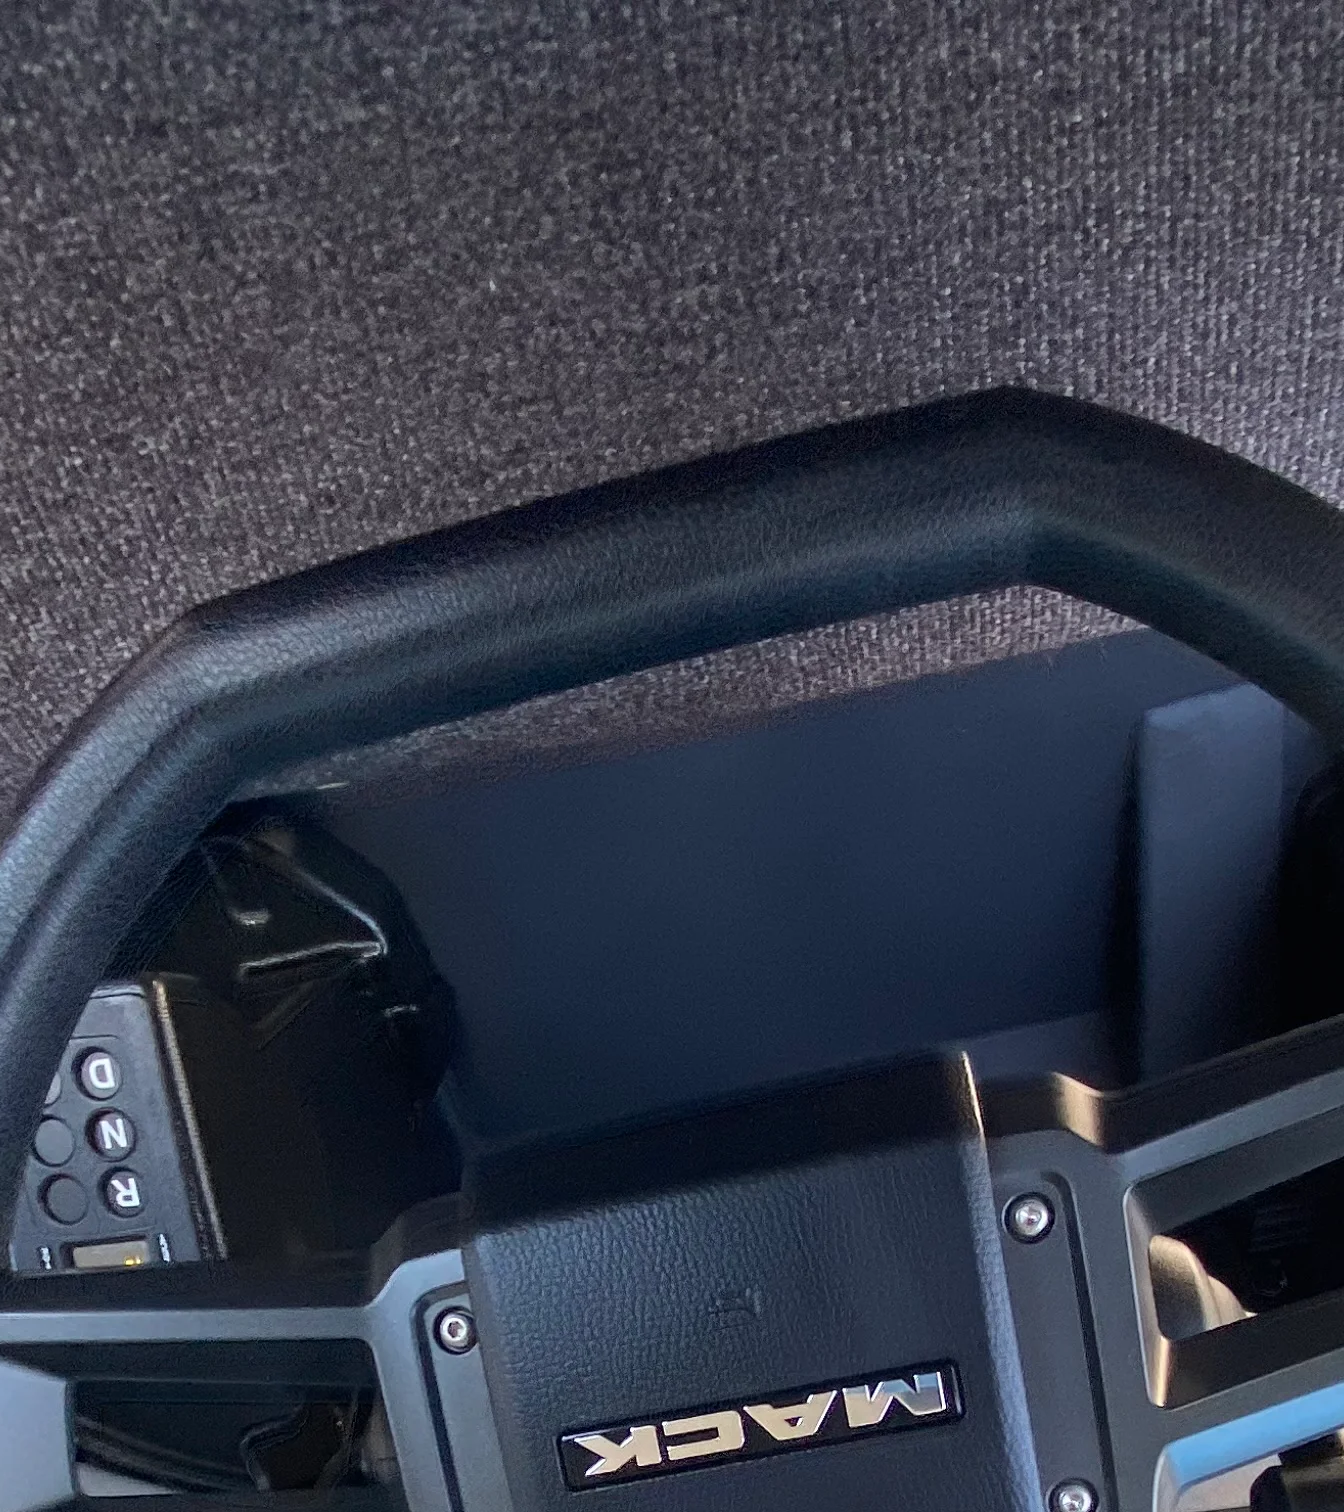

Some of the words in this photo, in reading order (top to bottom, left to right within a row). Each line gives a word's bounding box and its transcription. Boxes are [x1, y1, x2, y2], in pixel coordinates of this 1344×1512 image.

[88, 1057, 116, 1089] D
[98, 1118, 128, 1150] N
[111, 1177, 140, 1208] R
[573, 1372, 946, 1477] MACK
